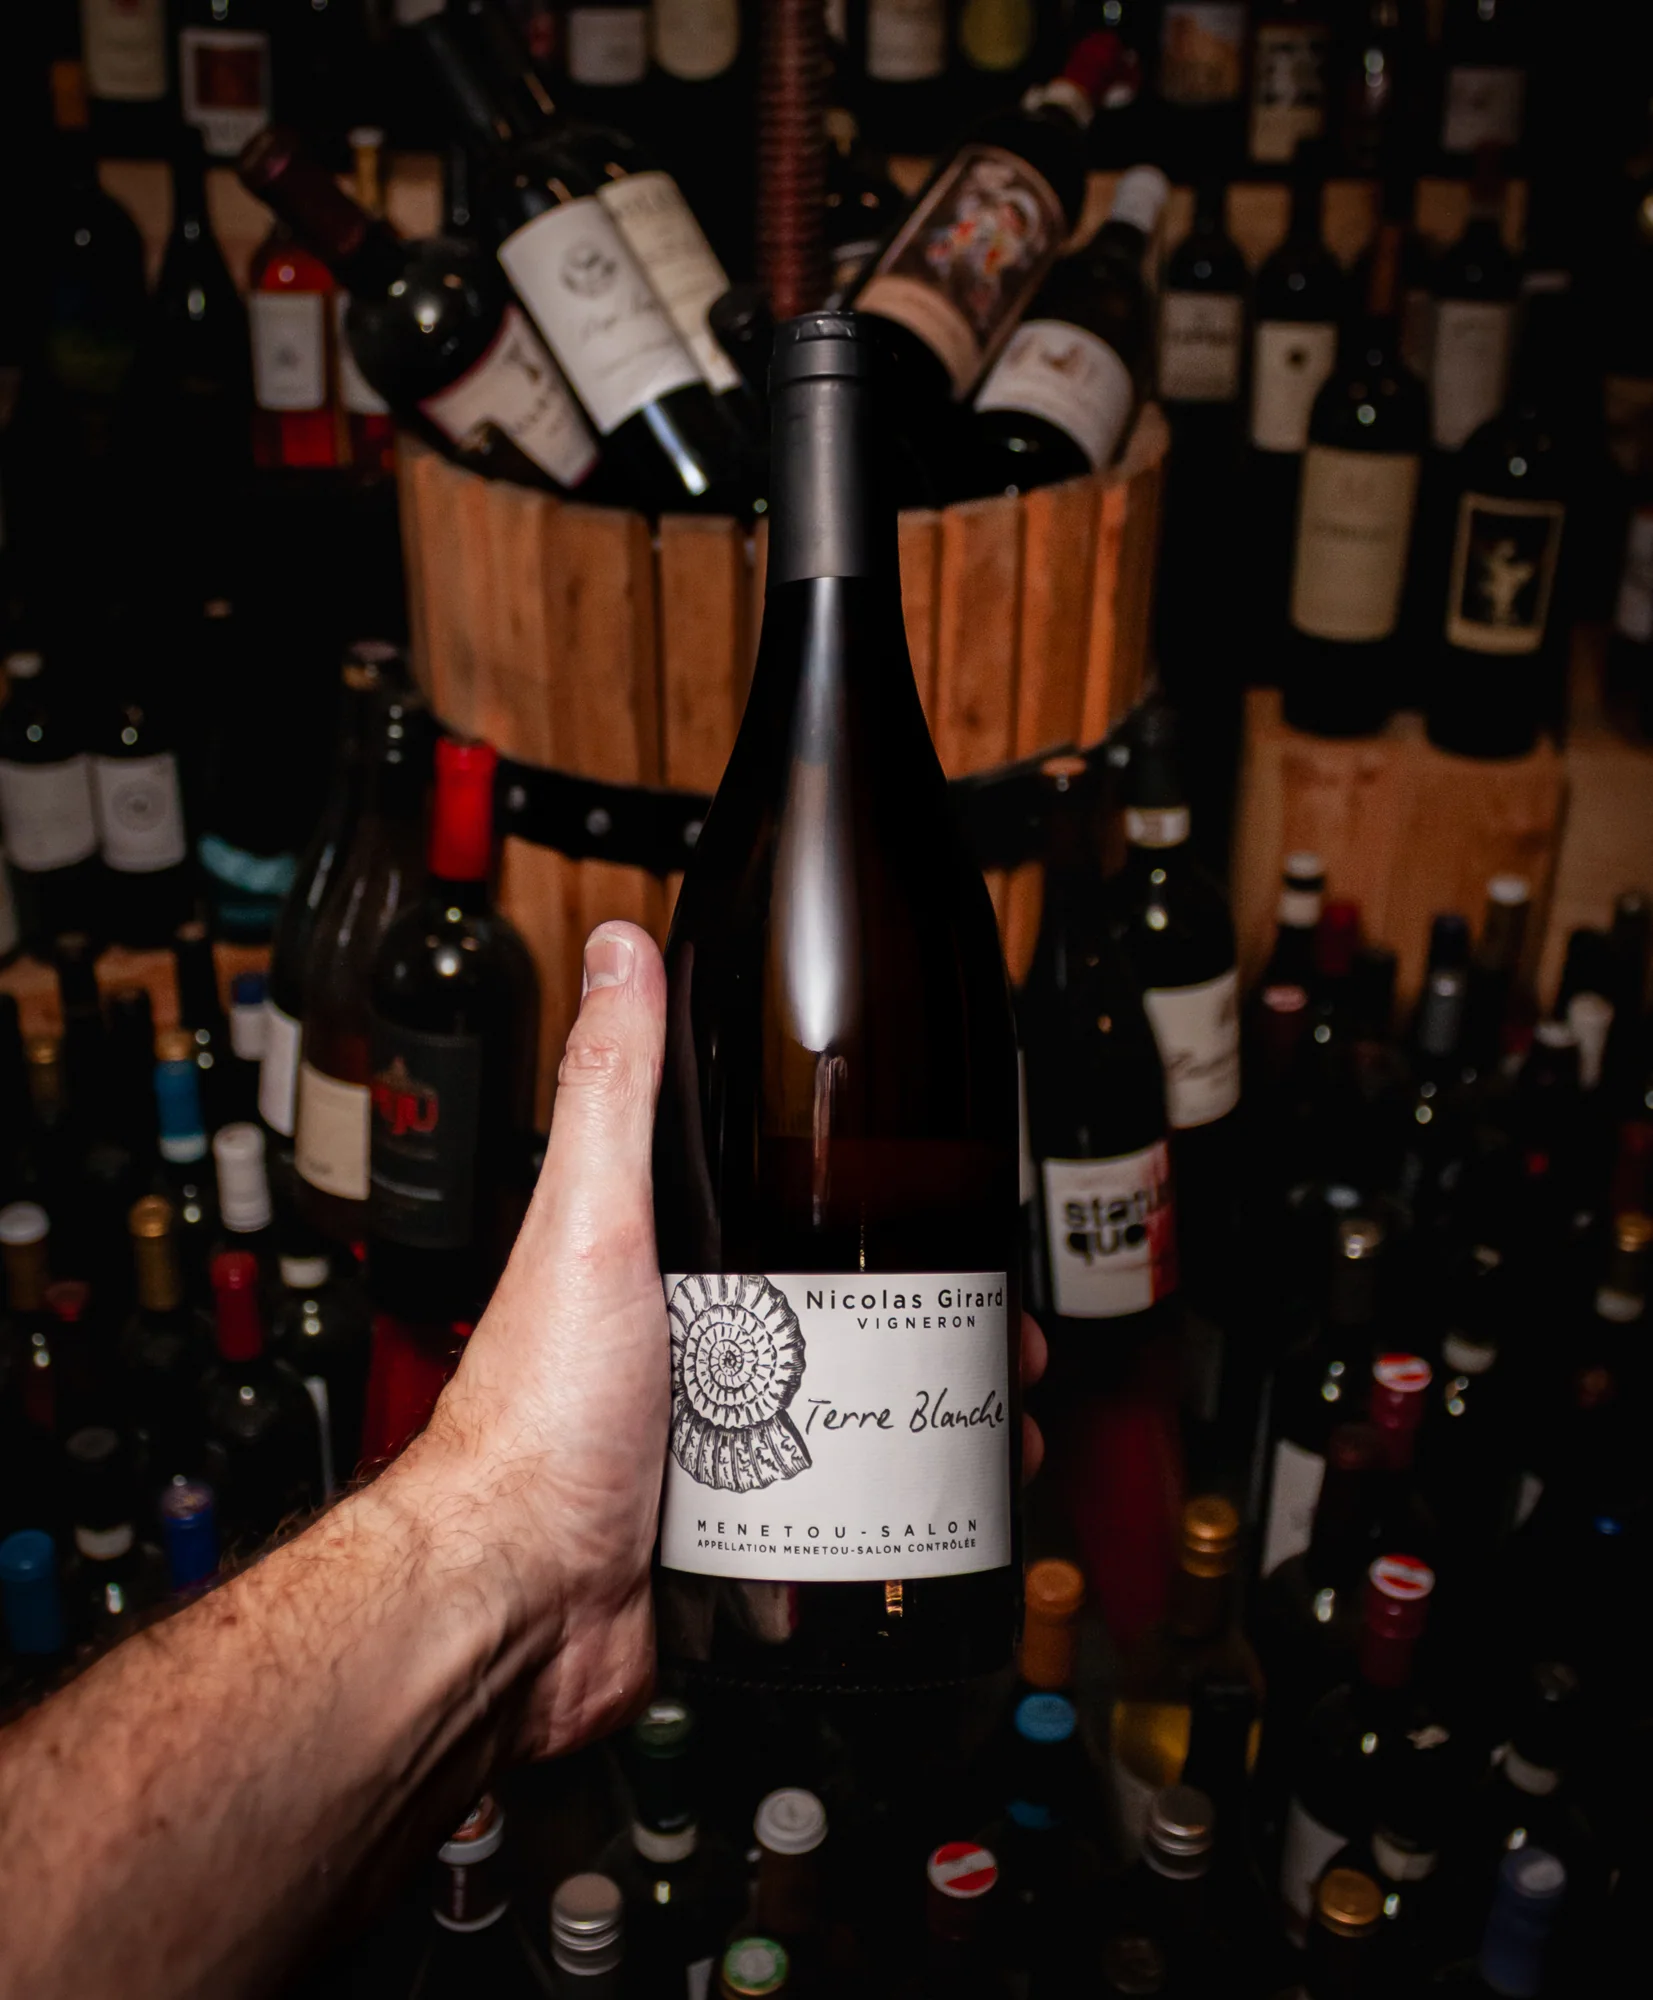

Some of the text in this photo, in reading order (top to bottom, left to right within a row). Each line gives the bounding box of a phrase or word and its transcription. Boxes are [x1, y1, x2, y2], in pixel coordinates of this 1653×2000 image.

[806, 1287, 1003, 1309] Nicolas Girard
[857, 1316, 976, 1329] VIGNERON
[805, 1388, 1004, 1435] Terre Blanche
[698, 1519, 977, 1539] MENETOU-SALON
[697, 1537, 976, 1555] APPELLATION MENETOU-SALON CONTRÔLÉE
